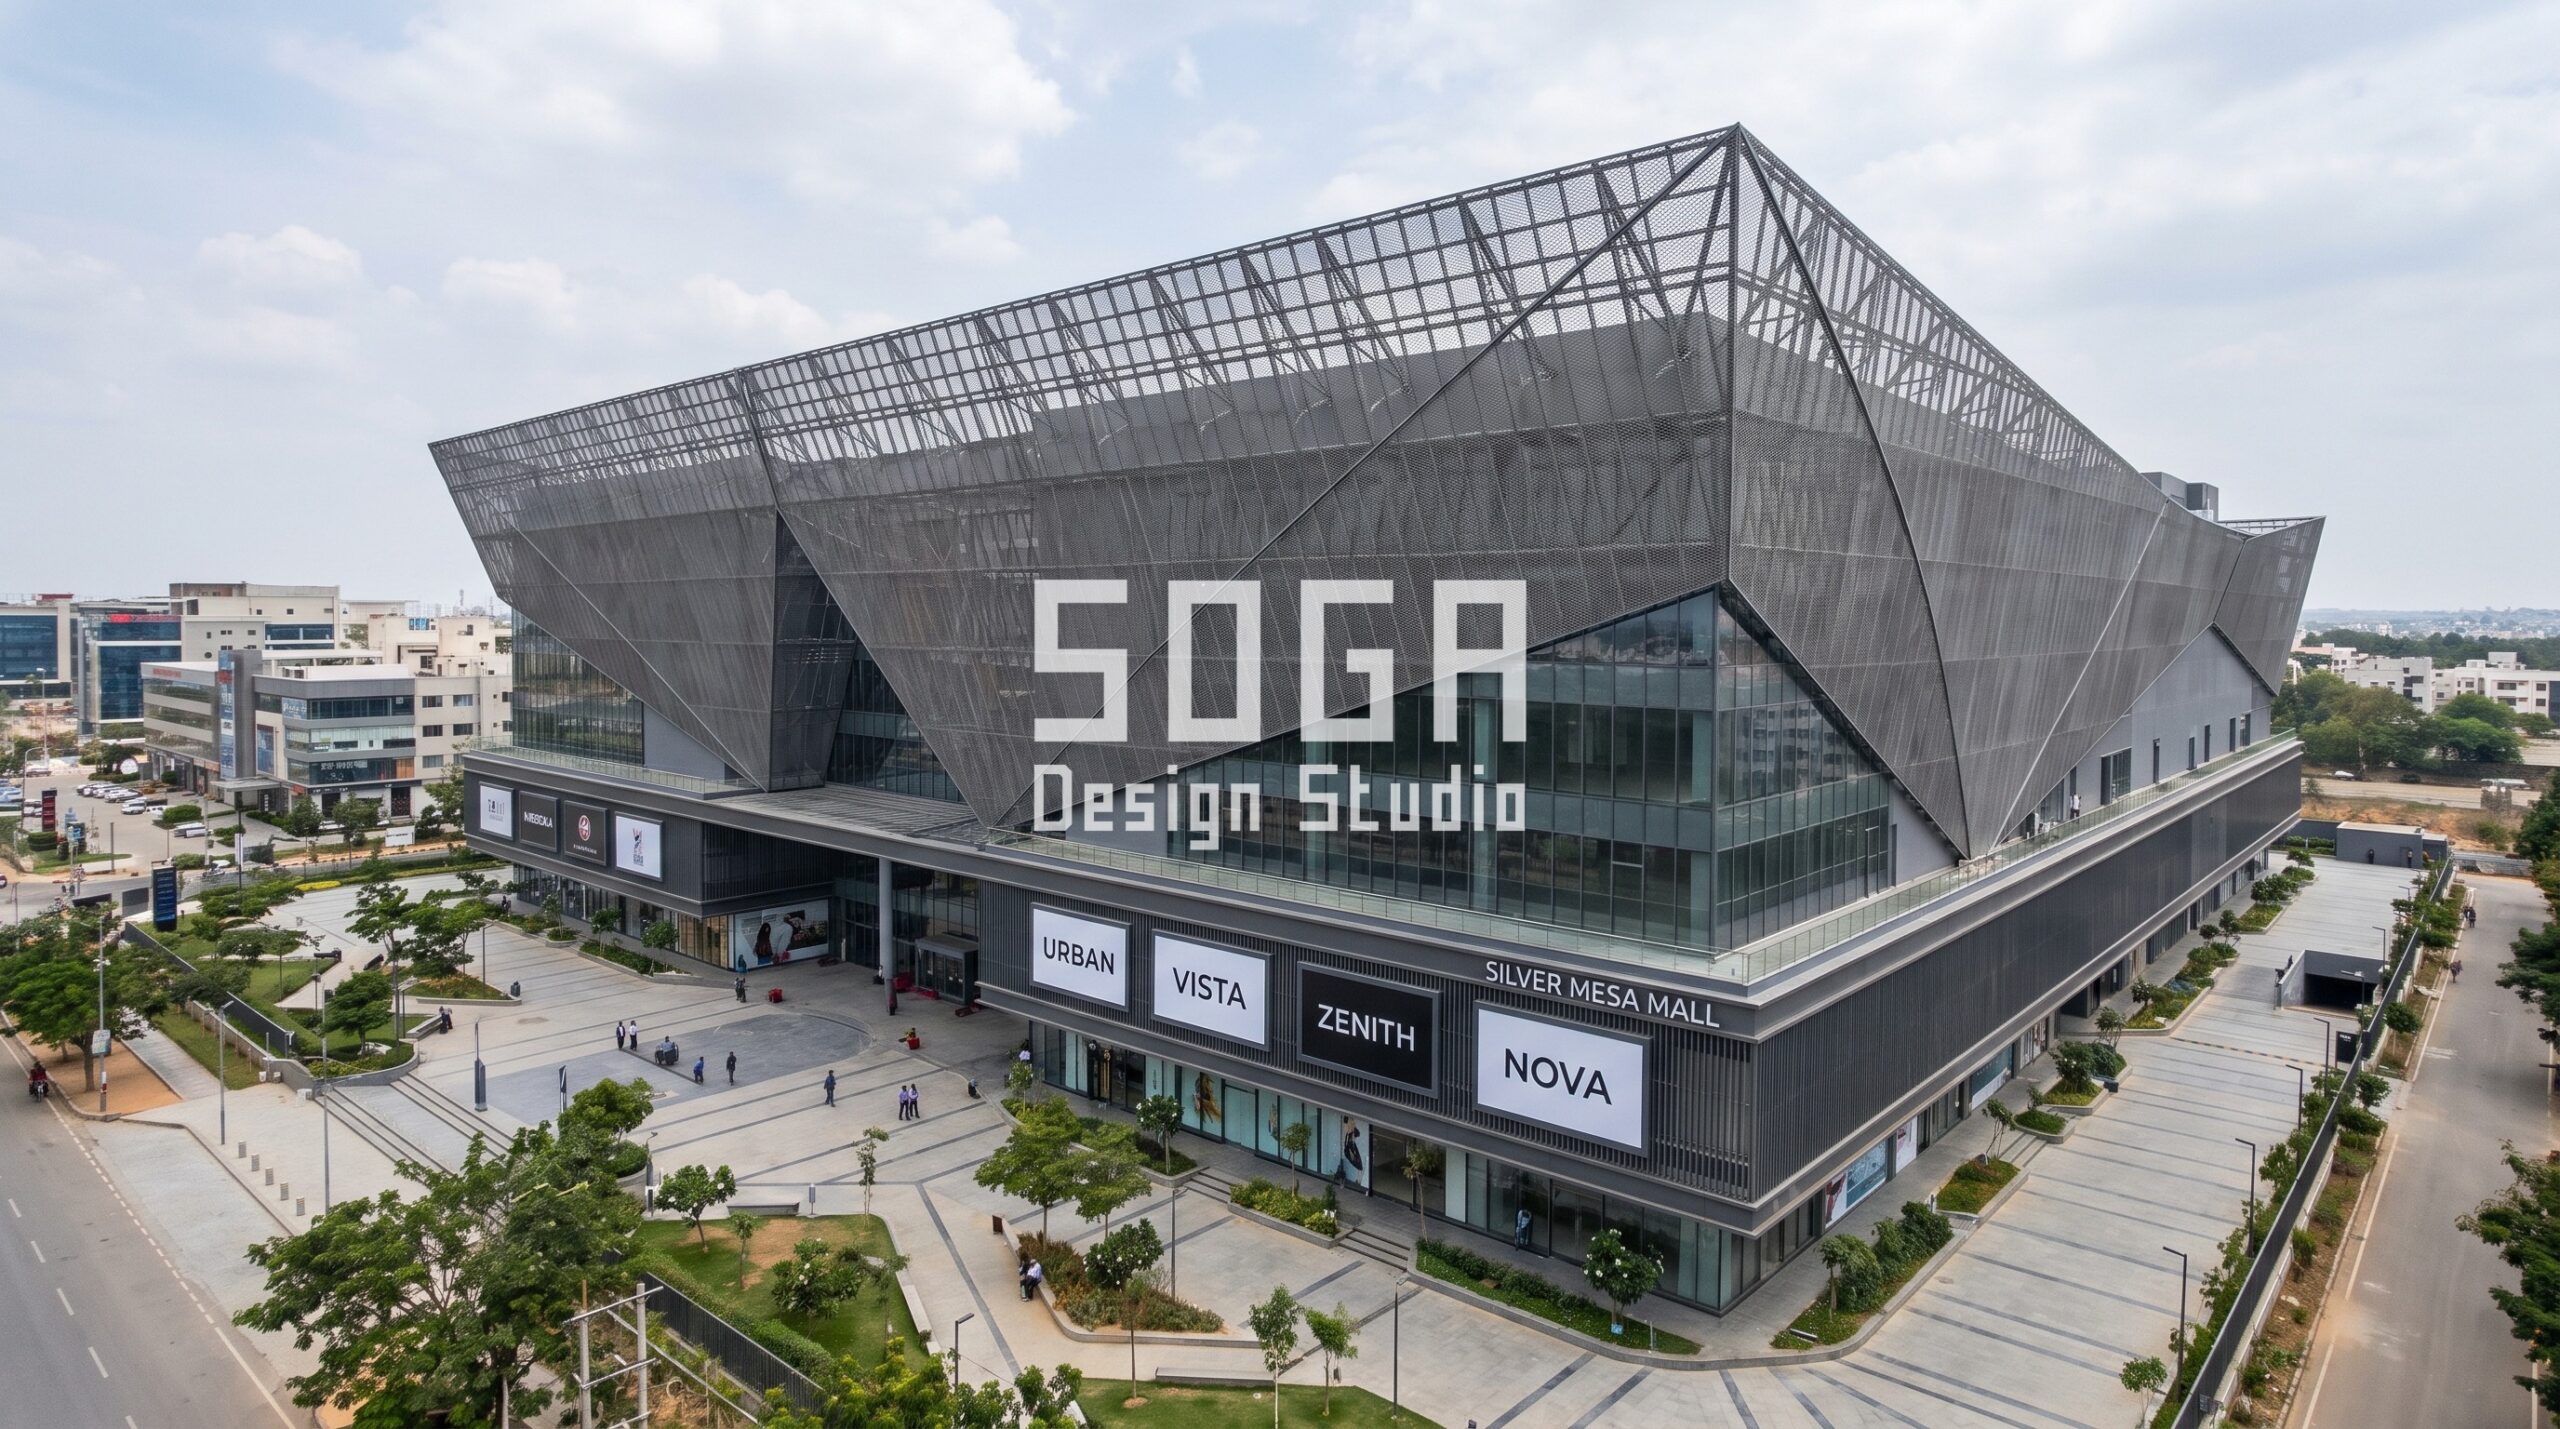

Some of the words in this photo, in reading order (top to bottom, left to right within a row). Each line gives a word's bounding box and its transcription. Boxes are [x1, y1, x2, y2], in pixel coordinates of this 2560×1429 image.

[1043, 936, 1115, 976] URBAN
[1172, 967, 1247, 1010] VISTA
[1485, 960, 1562, 996] SILVER
[1570, 977, 1640, 1012] MESA
[1648, 992, 1720, 1028] MALL
[1318, 1003, 1415, 1052] ZENITH
[1504, 1047, 1613, 1106] NOVA
